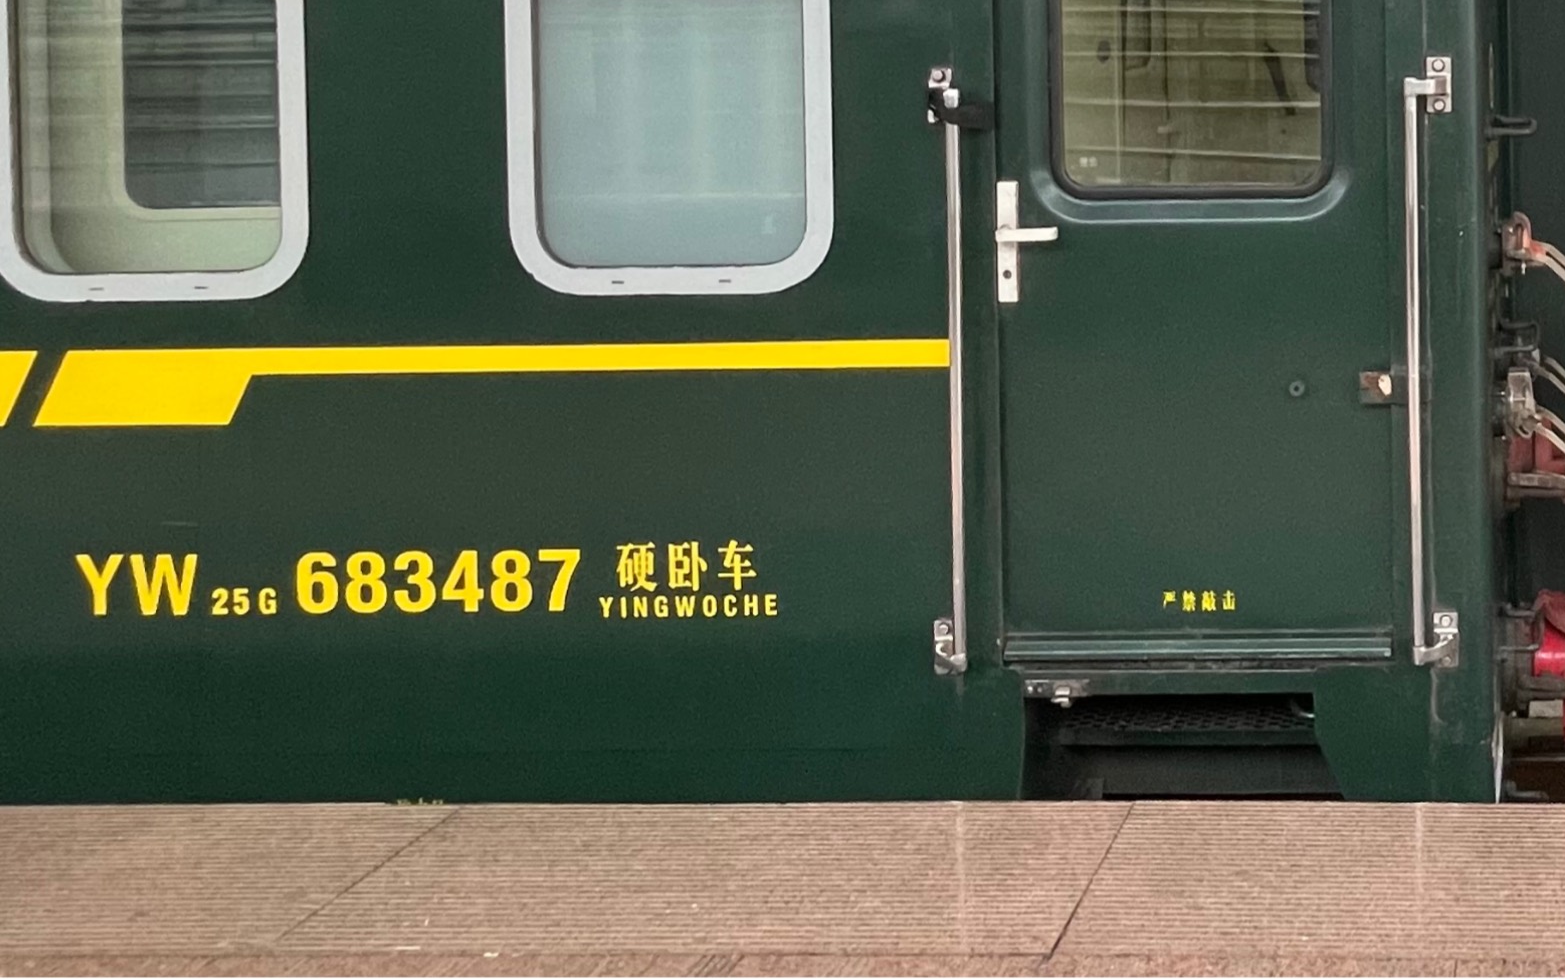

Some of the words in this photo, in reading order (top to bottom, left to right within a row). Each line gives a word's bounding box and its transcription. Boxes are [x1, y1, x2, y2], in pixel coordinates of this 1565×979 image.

[75, 552, 198, 617] YW
[211, 587, 278, 616] 25G
[295, 548, 582, 615] 683487
[615, 540, 757, 592] 硬卧车
[599, 593, 779, 618] YINGWOCHE
[1163, 590, 1236, 612] 严禁敲击
